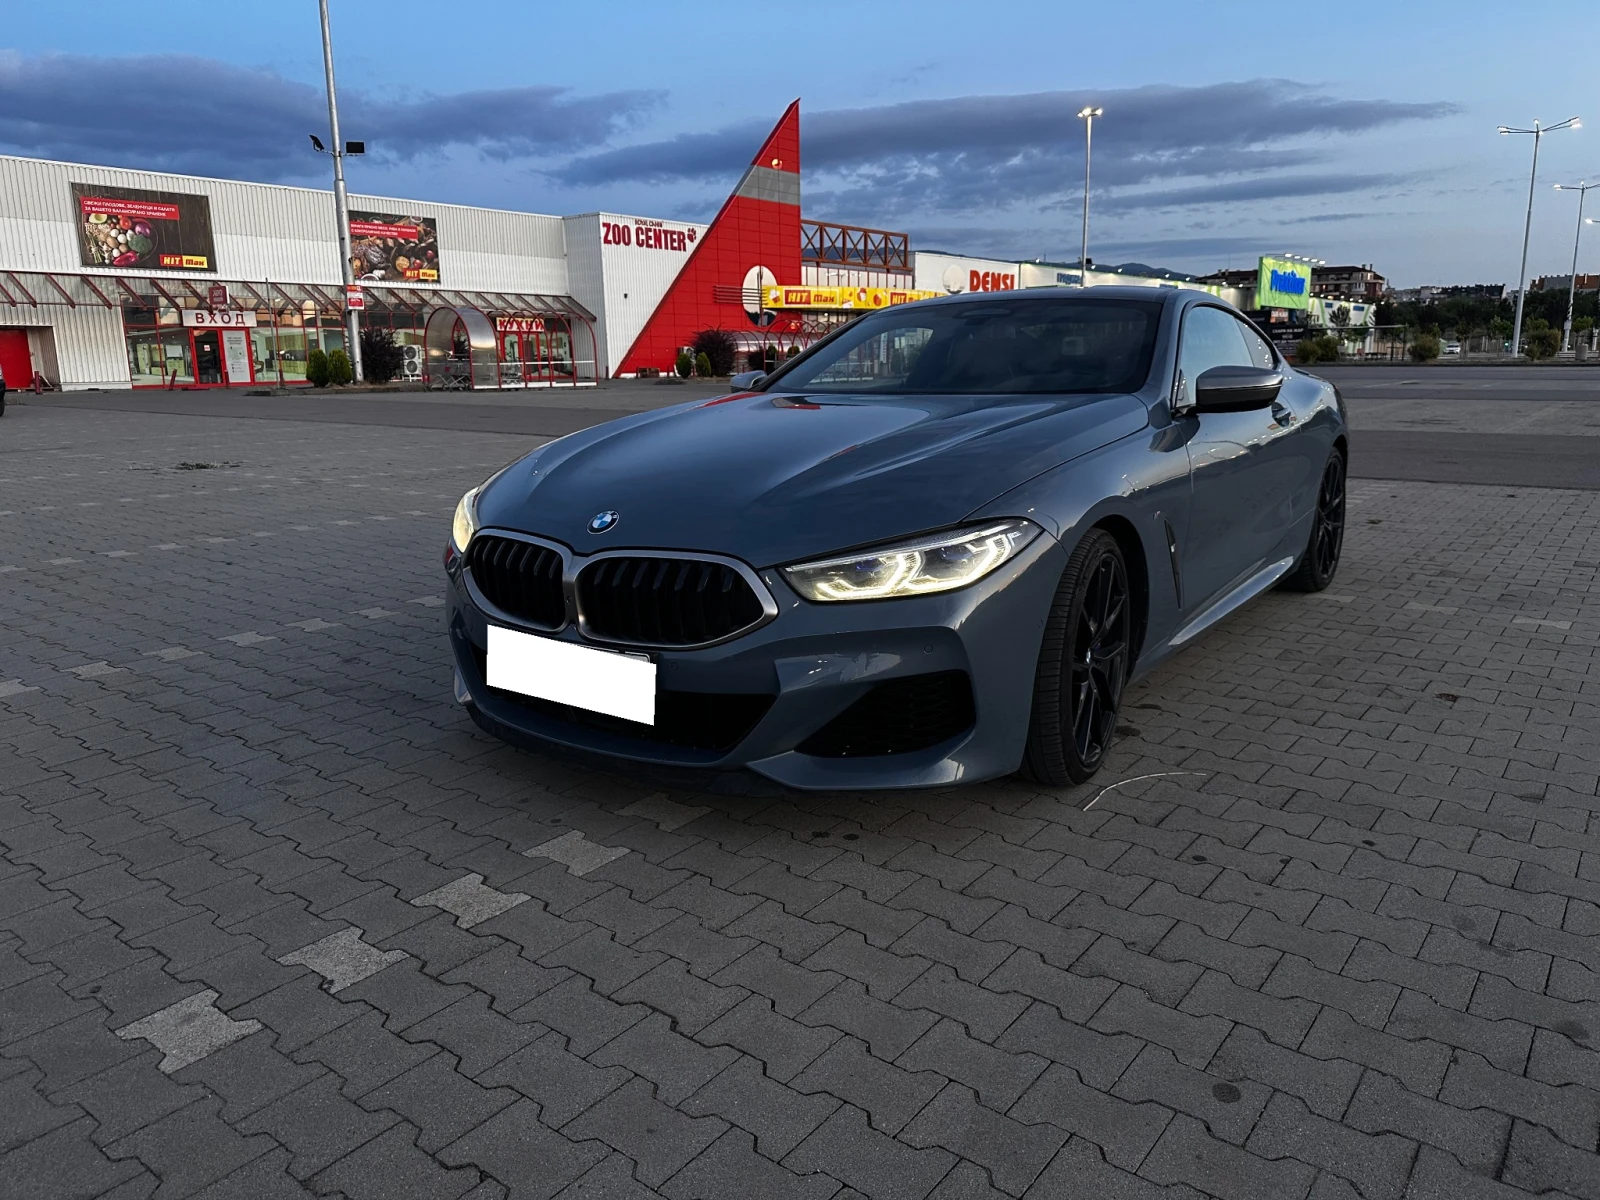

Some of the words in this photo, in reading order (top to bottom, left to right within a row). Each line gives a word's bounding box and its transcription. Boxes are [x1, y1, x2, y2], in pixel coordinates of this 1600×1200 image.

[602, 222, 631, 246] ZOO
[635, 226, 686, 252] CENTER
[164, 256, 180, 265] HIT
[969, 270, 1015, 292] DENSI
[787, 292, 808, 303] HIT
[892, 294, 905, 304] HIT
[195, 312, 246, 326] ВХОД
[498, 319, 544, 330] КУХНИ
